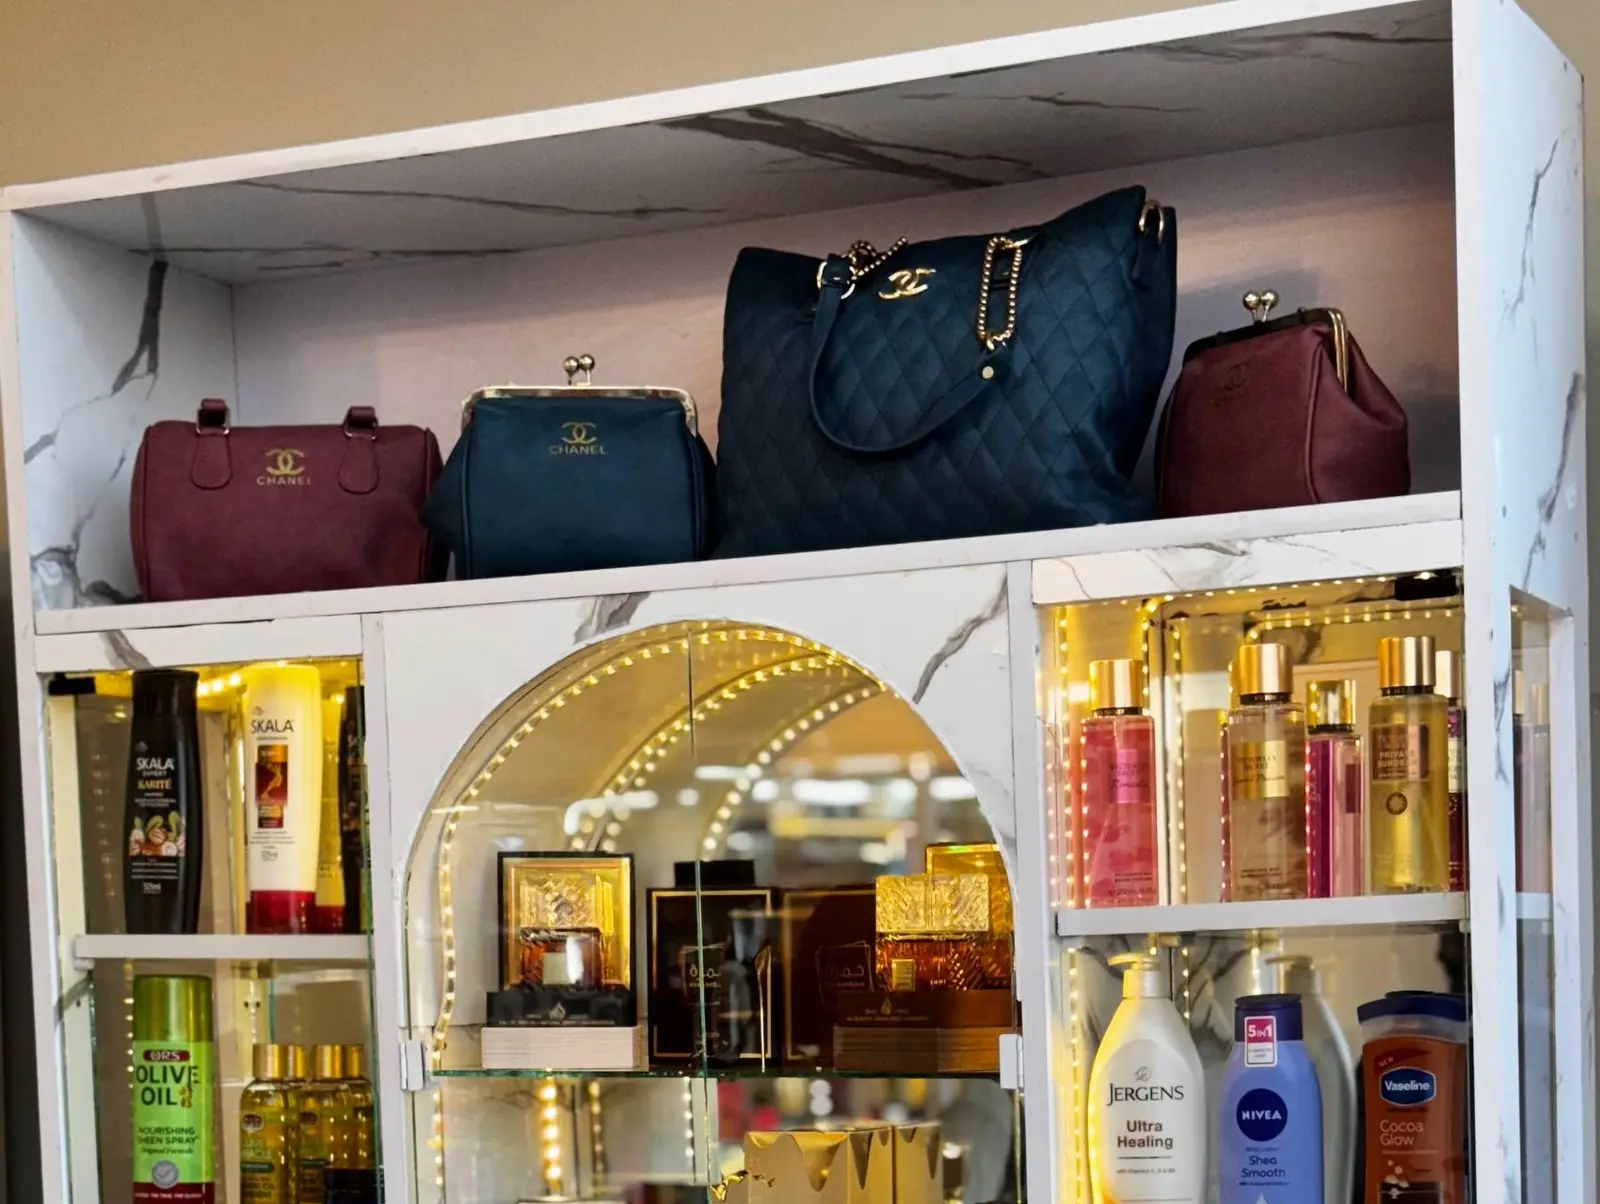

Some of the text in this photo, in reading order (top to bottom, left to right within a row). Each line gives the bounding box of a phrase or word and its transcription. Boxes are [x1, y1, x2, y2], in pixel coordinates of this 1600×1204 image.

[548, 444, 608, 456] CHANEL
[250, 718, 295, 734] SKALA
[135, 756, 176, 772] SKALA
[149, 1050, 181, 1061] ORS
[135, 1065, 201, 1085] OLIVE
[1384, 1079, 1432, 1091] Vaseline
[140, 1086, 178, 1107] OIL
[1105, 1082, 1185, 1107] JERGENS
[1241, 1108, 1283, 1121] NIVEA
[1126, 1119, 1163, 1133] Ultra
[1379, 1119, 1424, 1133] Cocoa
[1116, 1135, 1174, 1151] Healing
[1380, 1132, 1415, 1147] Glow
[1248, 1154, 1278, 1166] Shea
[1241, 1167, 1286, 1179] Smooth
